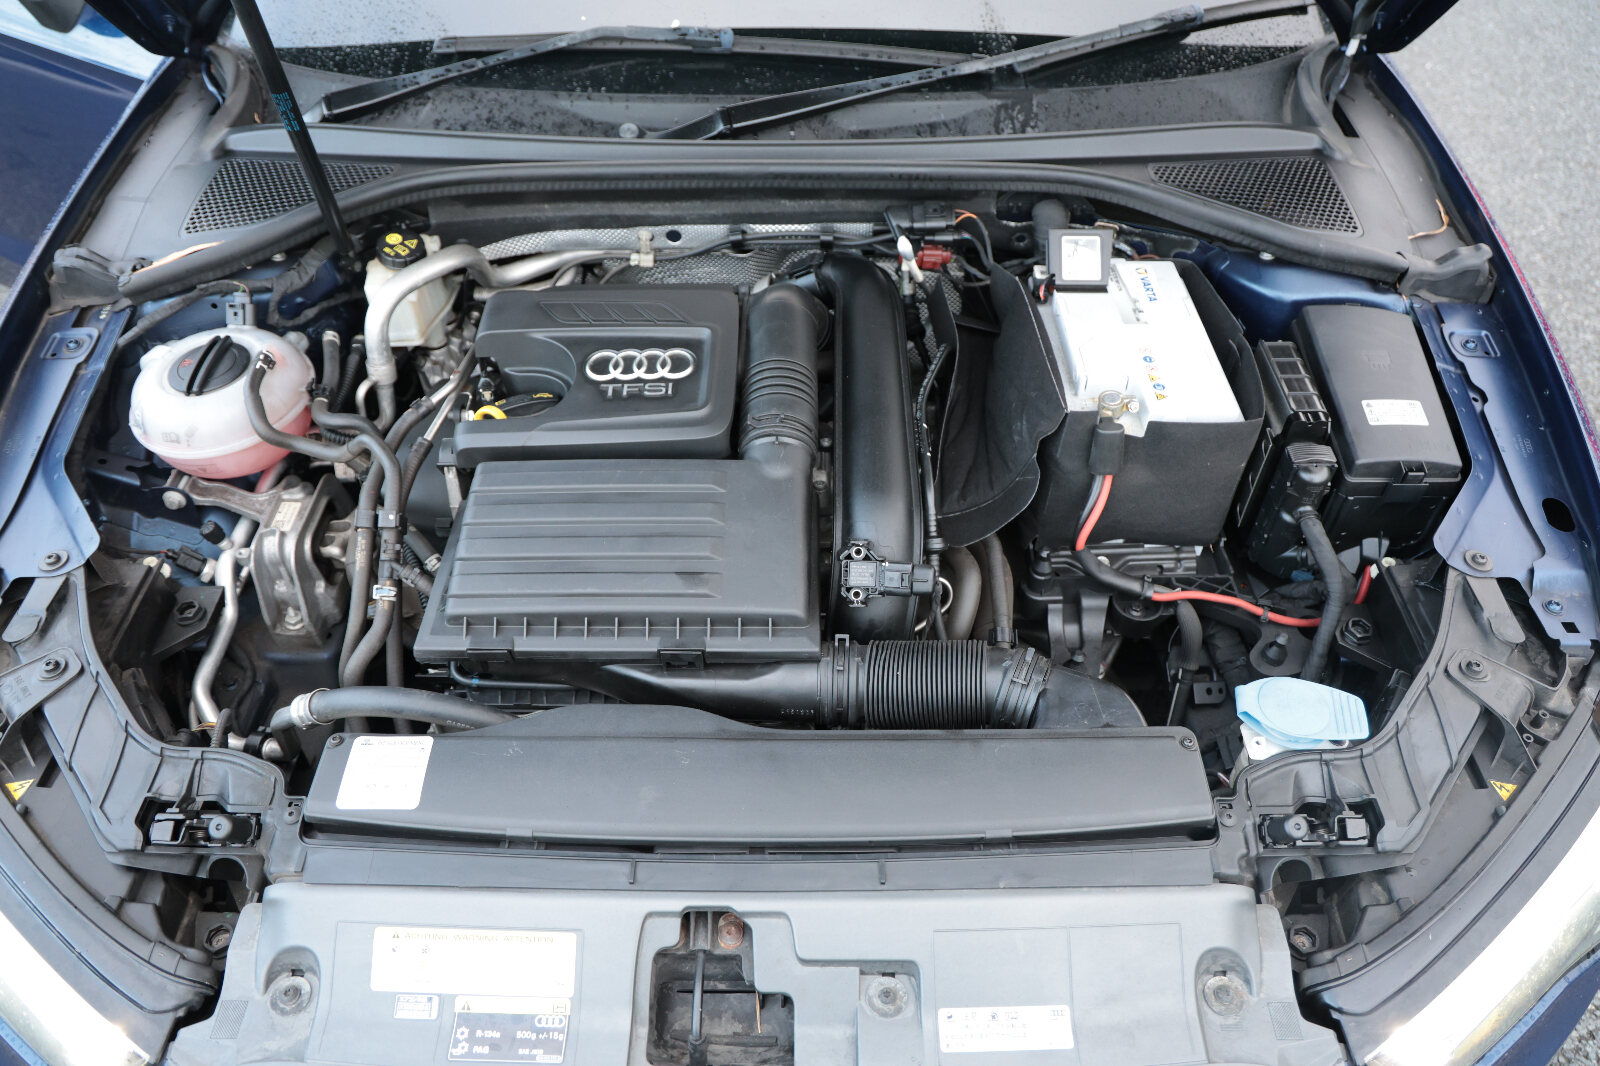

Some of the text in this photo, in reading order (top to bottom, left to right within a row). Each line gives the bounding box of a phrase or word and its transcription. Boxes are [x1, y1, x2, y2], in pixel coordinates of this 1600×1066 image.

[1140, 276, 1157, 302] VARTA
[600, 382, 673, 399] TFSI
[476, 1029, 501, 1038] R-134a
